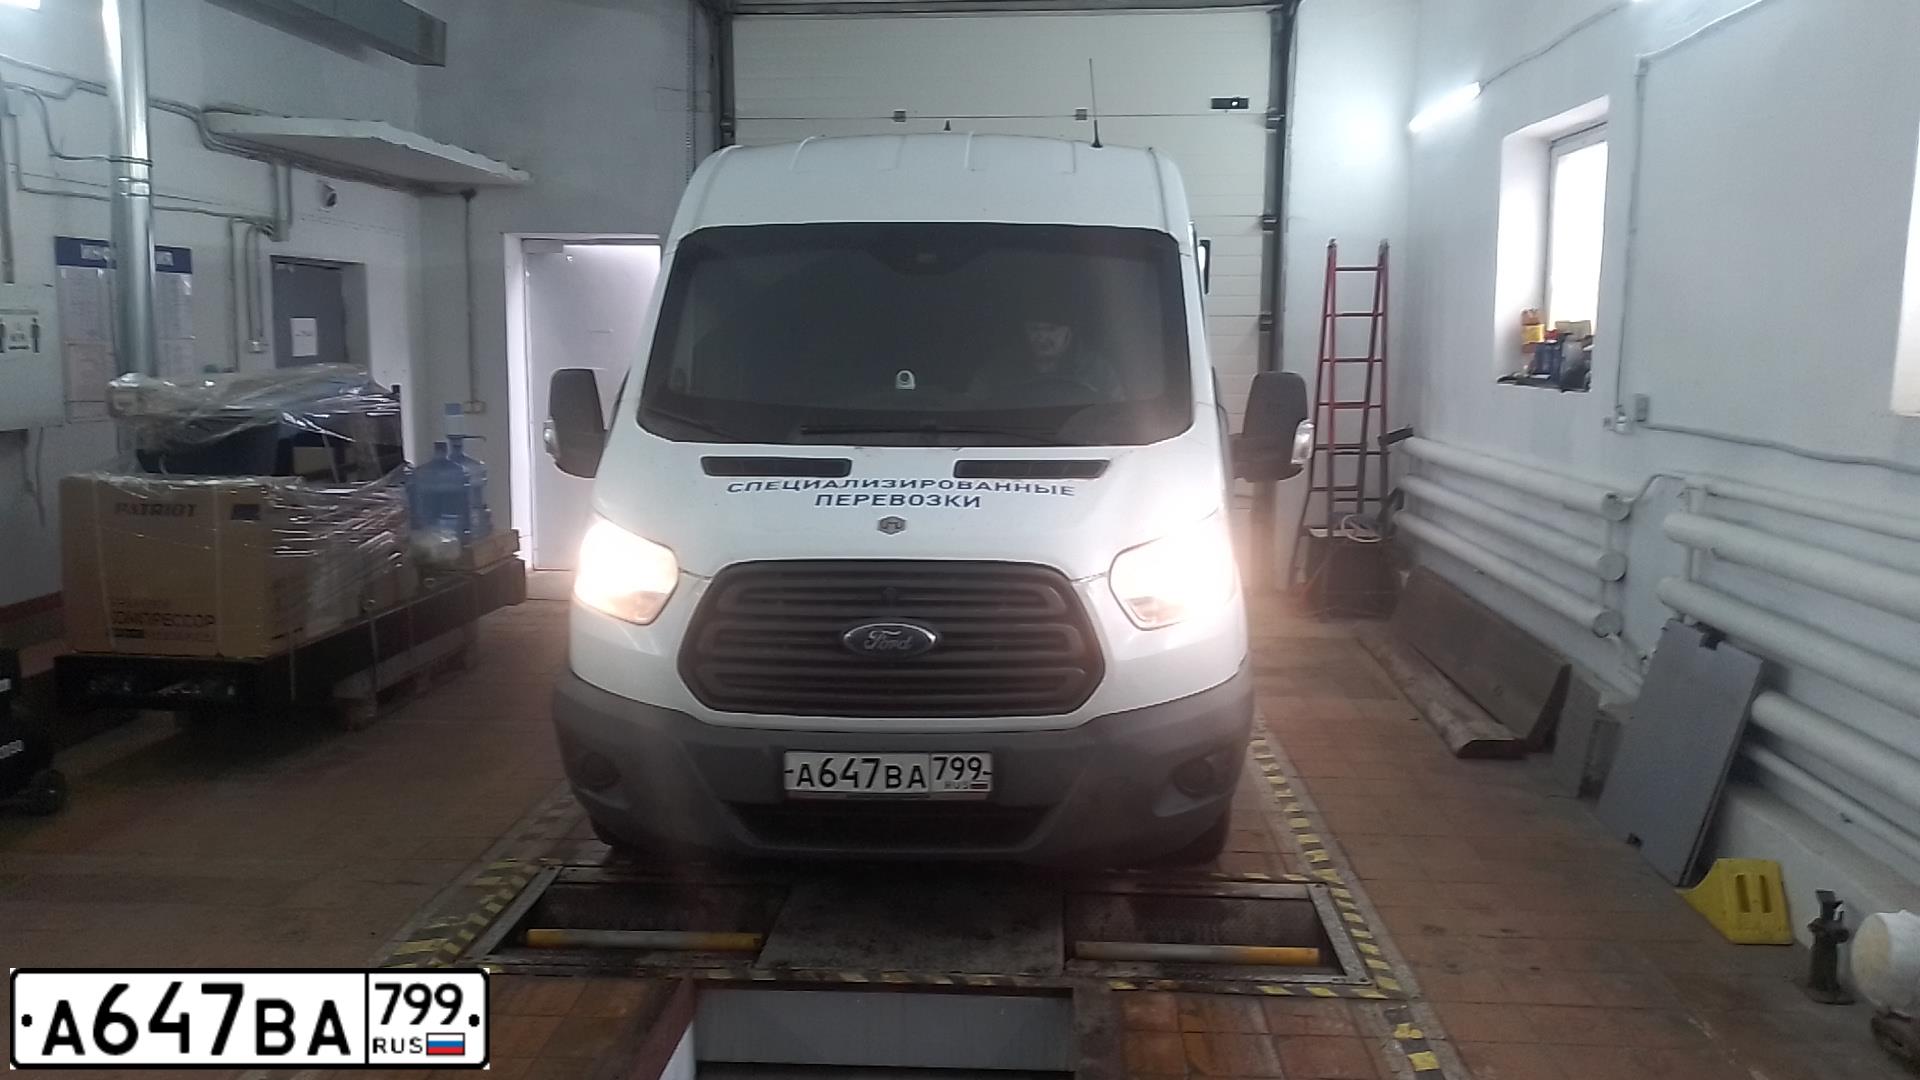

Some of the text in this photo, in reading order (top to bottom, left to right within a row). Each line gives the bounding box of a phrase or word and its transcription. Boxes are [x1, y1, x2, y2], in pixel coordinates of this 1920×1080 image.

[727, 479, 1075, 497] СПЕЦИАЛИЗИРОВАННЫЕ
[115, 502, 197, 518] PATRIOT
[815, 494, 981, 508] ПЕРЕВОЗКИ
[863, 630, 913, 650] Ford
[933, 756, 982, 781] 799
